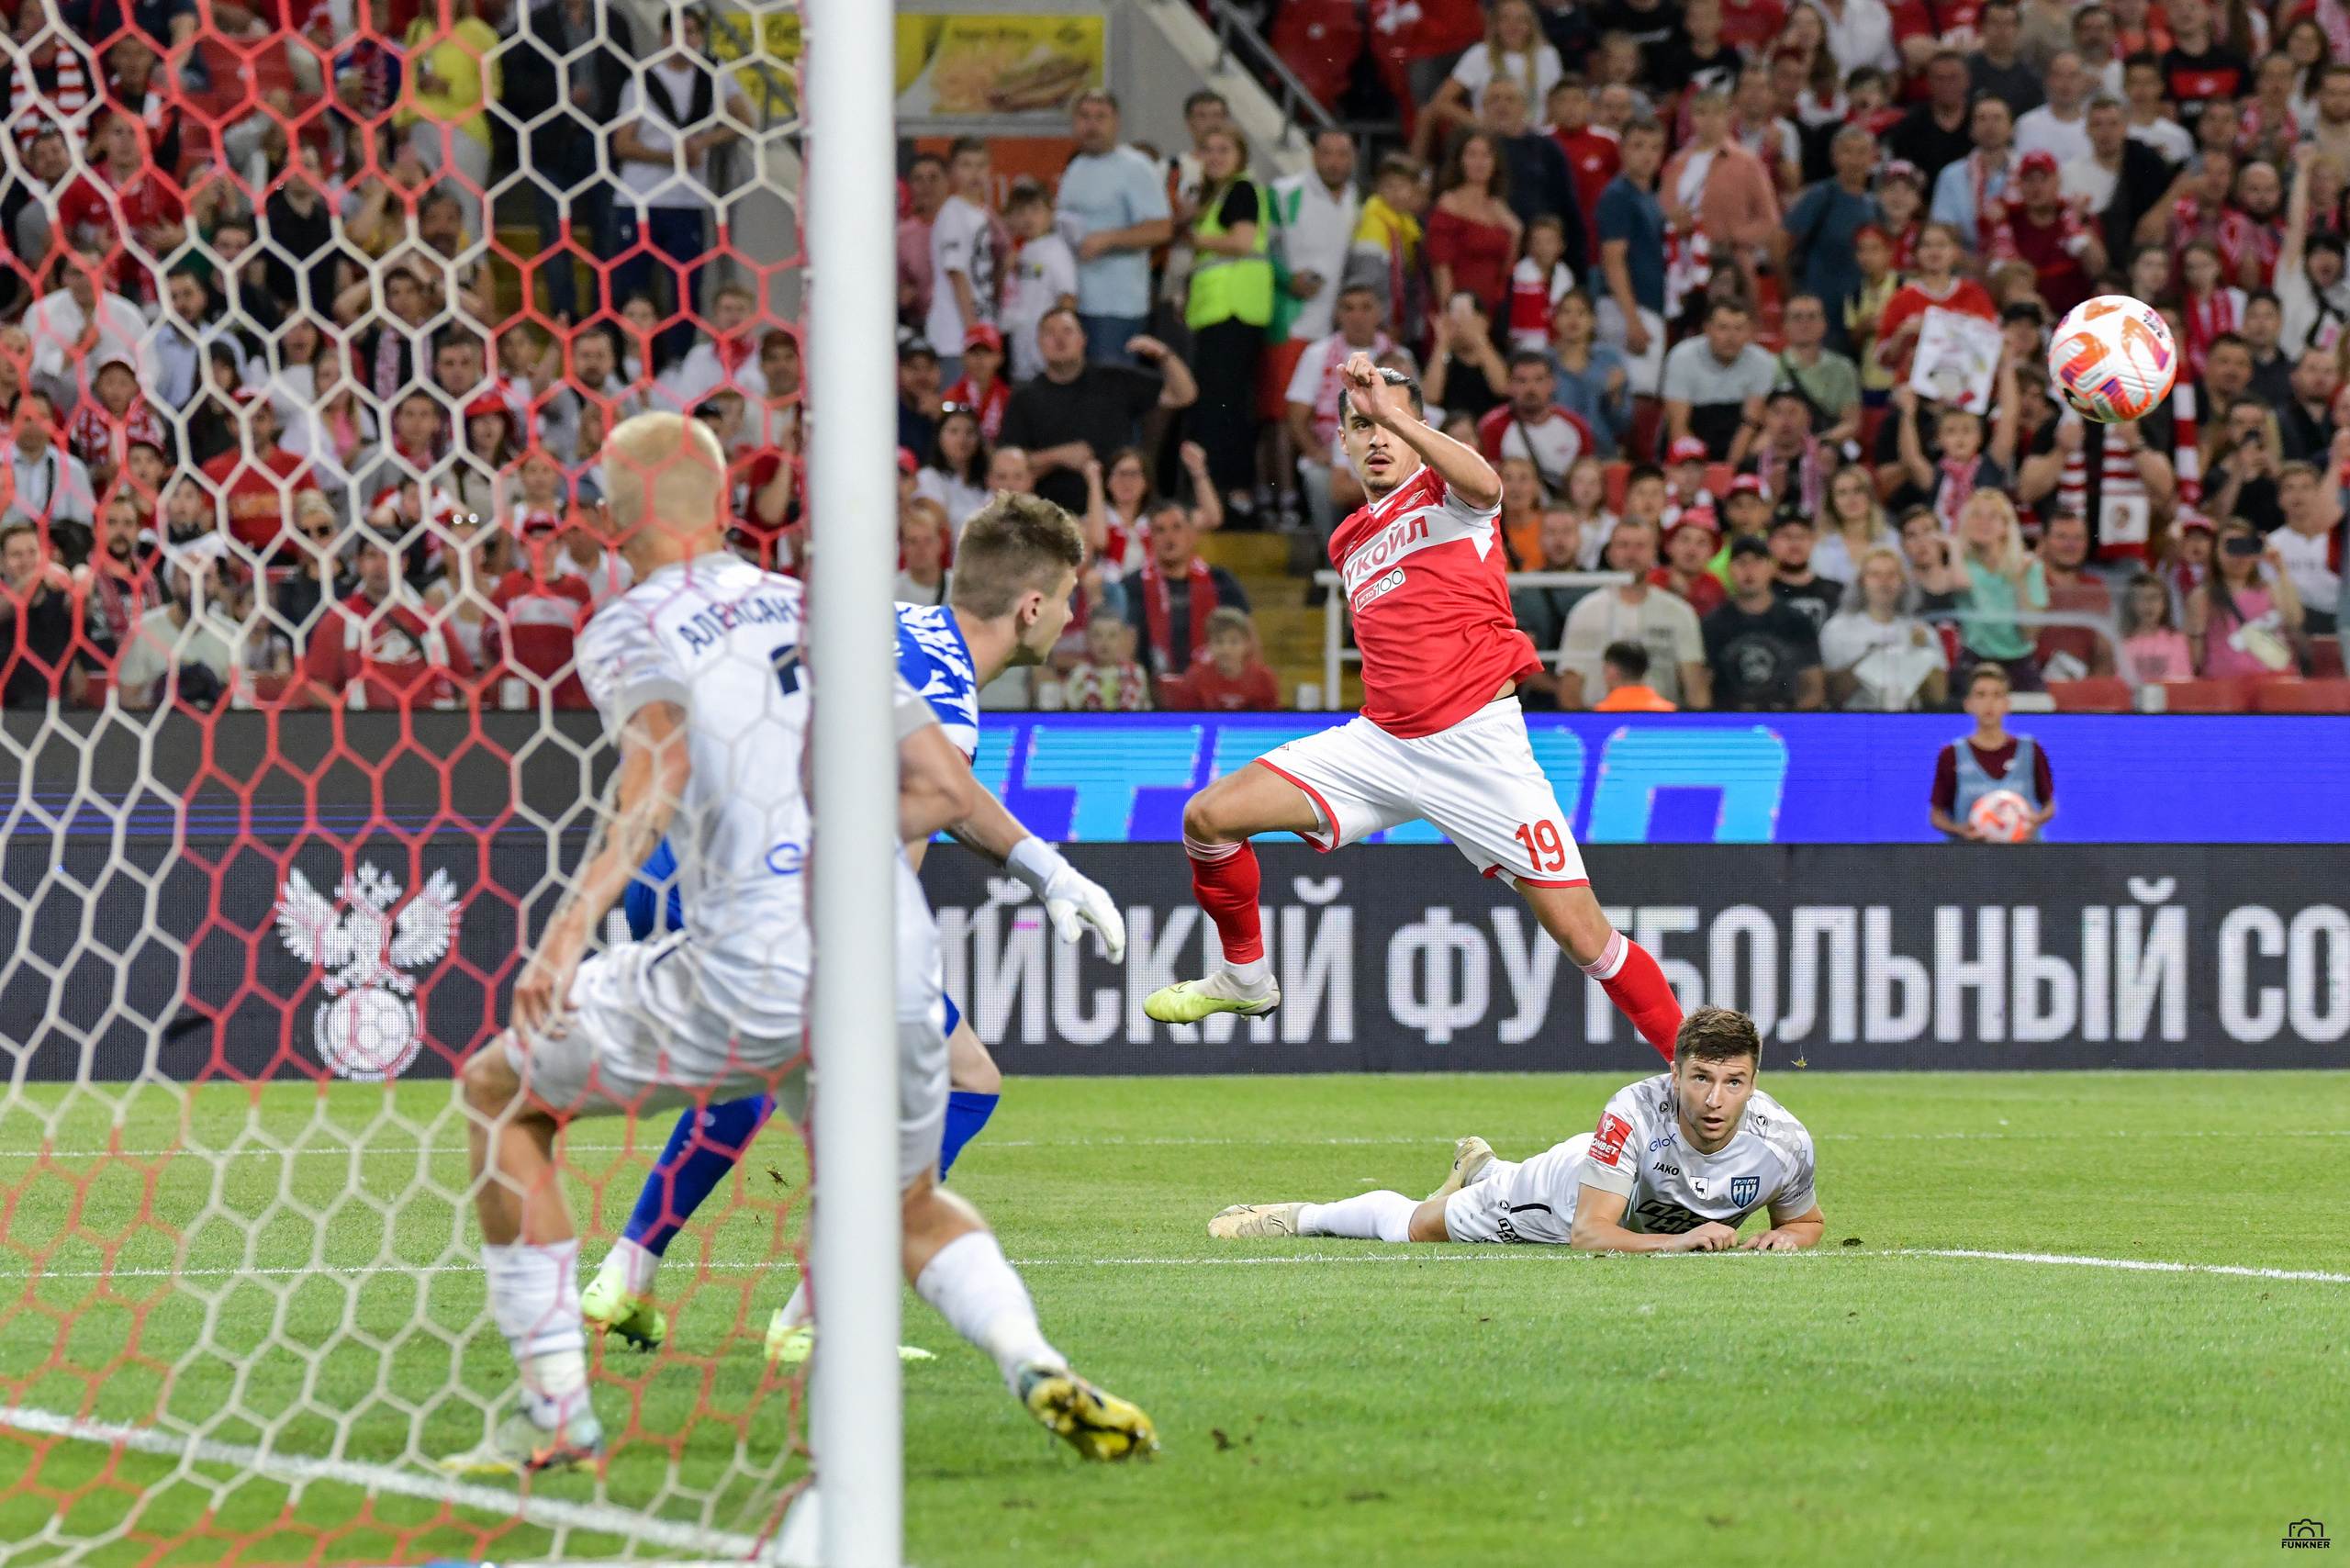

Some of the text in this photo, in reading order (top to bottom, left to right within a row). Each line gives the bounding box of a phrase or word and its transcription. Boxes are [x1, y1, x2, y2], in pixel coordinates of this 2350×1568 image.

[1343, 515, 1429, 588] УКОЙЛ
[677, 598, 800, 655] АЛЕКСАН
[1515, 819, 1566, 873] 19
[1653, 1161, 1680, 1176] JAKO
